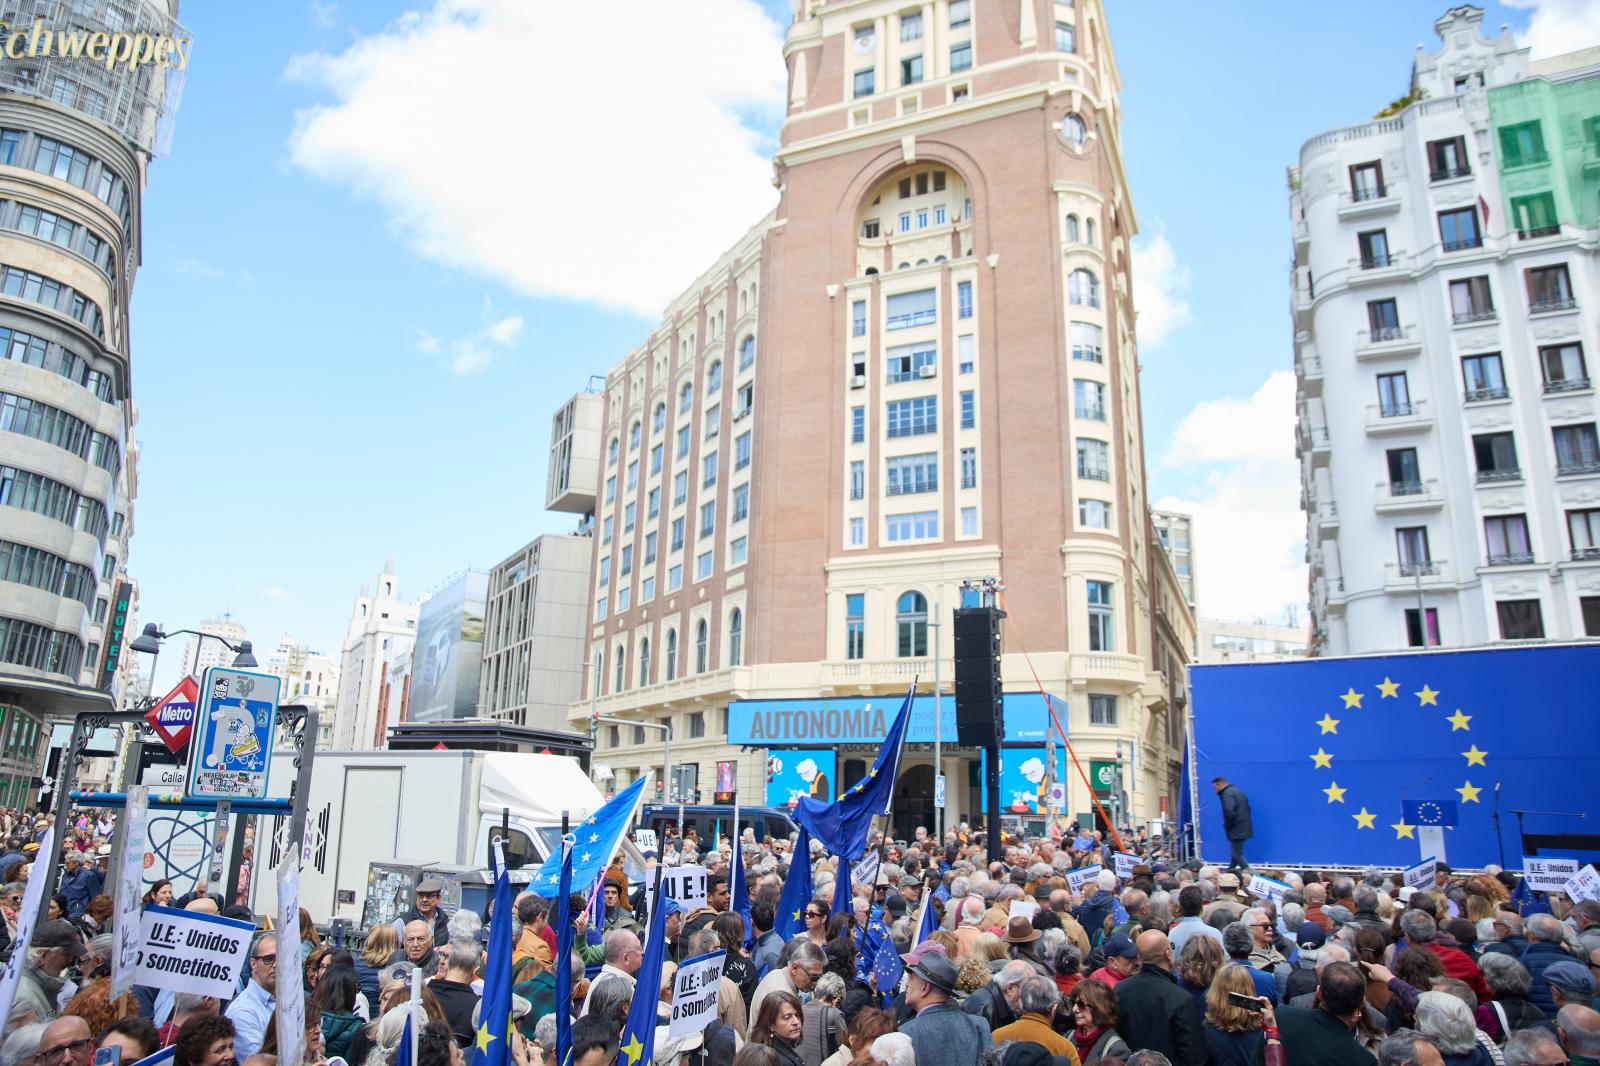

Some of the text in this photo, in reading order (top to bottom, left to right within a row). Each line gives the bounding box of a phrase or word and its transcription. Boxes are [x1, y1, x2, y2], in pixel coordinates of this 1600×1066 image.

[106, 600, 129, 672] HOTEL
[161, 706, 193, 722] Metro
[749, 704, 887, 739] AUTONOMÍA
[1548, 864, 1574, 872] Unidos
[1535, 876, 1570, 885] sometido
[150, 923, 240, 955] U.E.: Unidos
[146, 953, 232, 982] sometidos.
[681, 974, 700, 993] U.E.:
[673, 1006, 679, 1020] o
